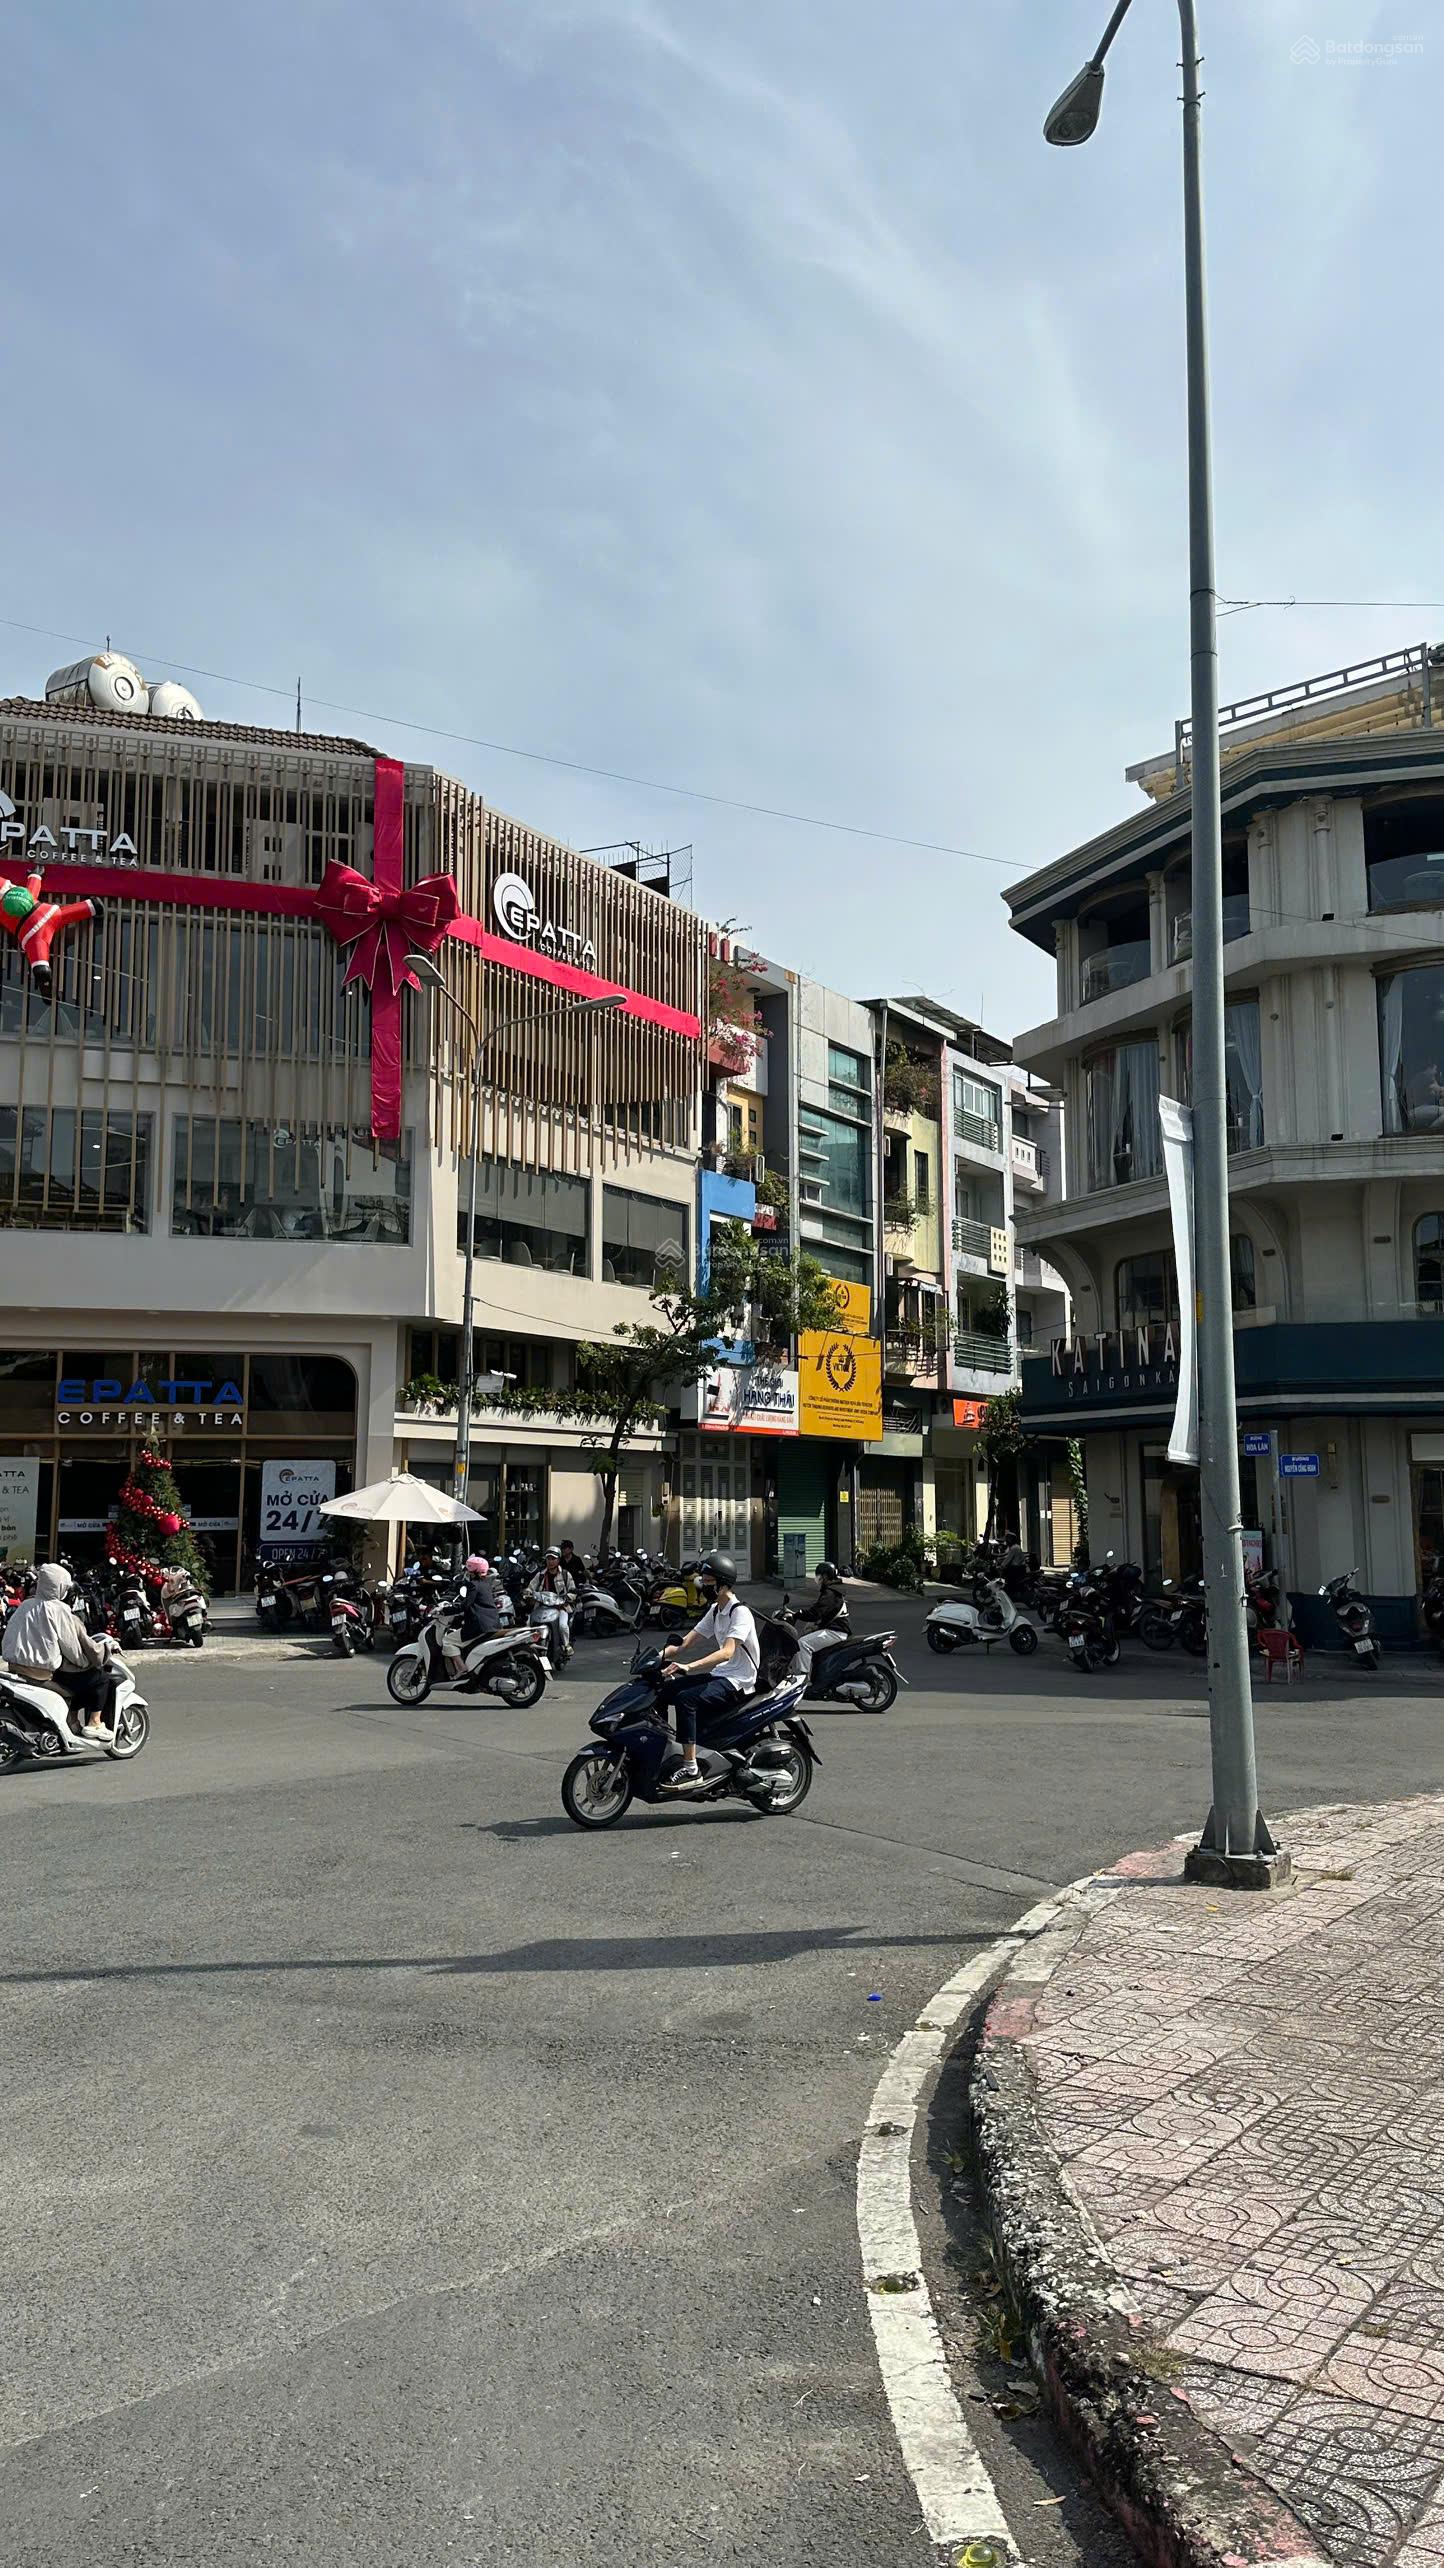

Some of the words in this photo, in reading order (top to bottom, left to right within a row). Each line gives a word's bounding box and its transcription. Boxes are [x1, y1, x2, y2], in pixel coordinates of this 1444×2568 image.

[27, 849, 87, 863] COFFEE
[95, 855, 103, 864] &
[112, 857, 138, 867] TEA
[510, 906, 596, 960] EPATTA
[57, 1379, 244, 1405] EPATTA
[773, 1389, 795, 1408] THÁI
[57, 1412, 160, 1425] COFFEE
[173, 1412, 185, 1424] &
[199, 1412, 243, 1425] TEA
[13, 1485, 29, 1495] TEA
[267, 1490, 292, 1506] MỞ
[297, 1490, 329, 1506] CỬA
[272, 1548, 296, 1560] OPEN
